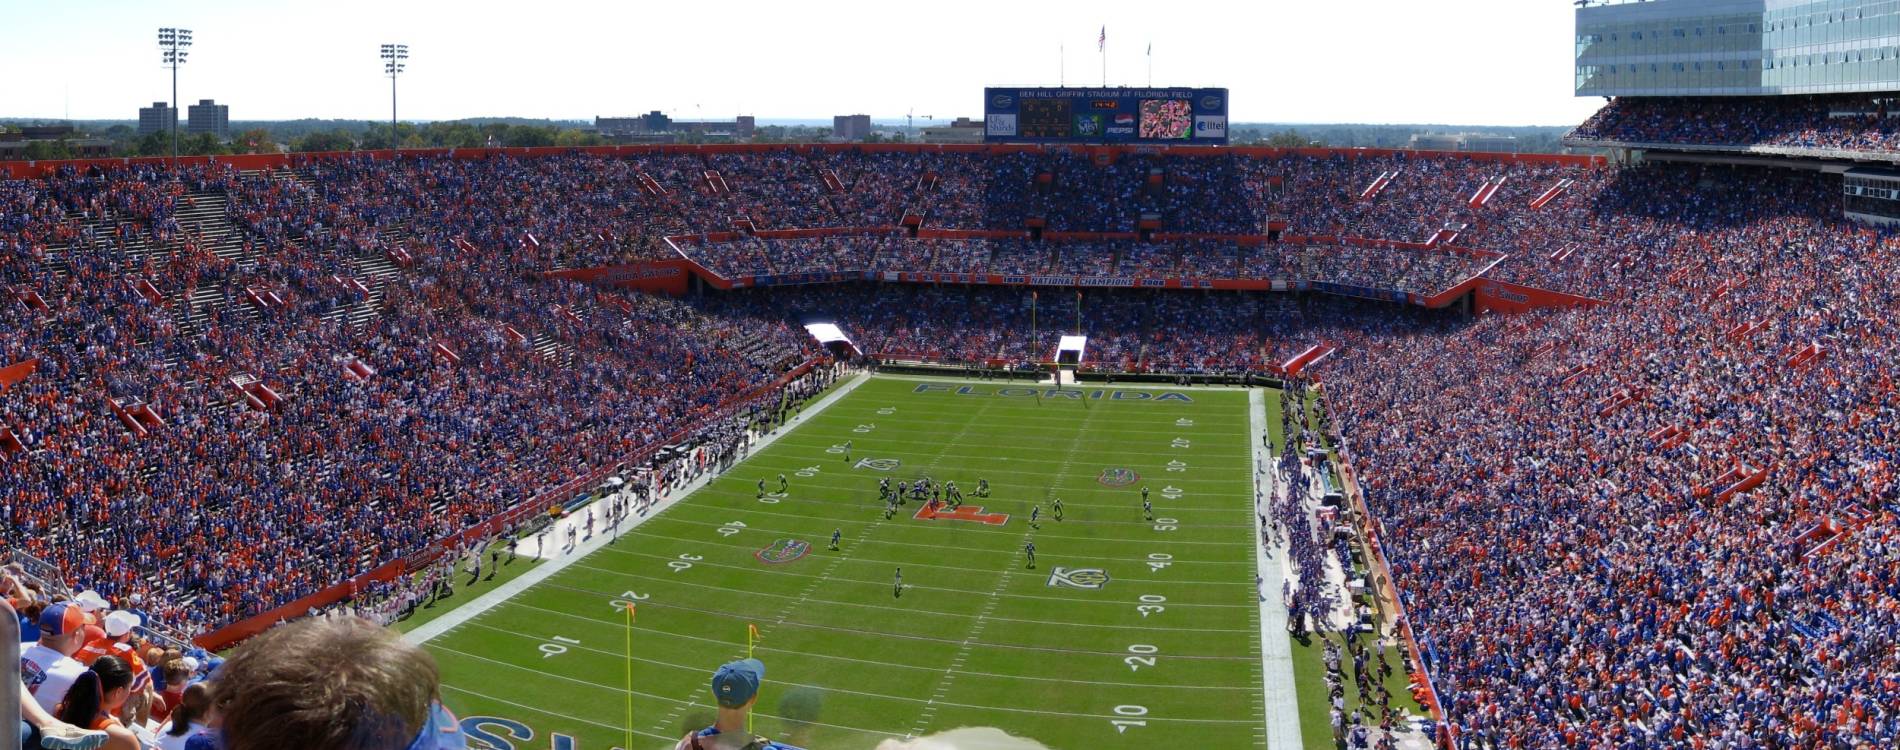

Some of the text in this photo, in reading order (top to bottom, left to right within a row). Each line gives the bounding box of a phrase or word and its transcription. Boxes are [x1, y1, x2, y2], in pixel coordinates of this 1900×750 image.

[1037, 90, 1051, 98] HILL
[1087, 90, 1119, 98] STADIUM
[1122, 90, 1131, 98] AT
[1031, 276, 1075, 286] NATIONAL
[1079, 277, 1134, 286] CHAMPIONS
[912, 383, 1194, 402] FLORIDA
[1161, 487, 1184, 499] 40
[717, 521, 747, 534] 40
[1154, 518, 1178, 531] 50
[668, 553, 703, 569] 30
[1147, 553, 1173, 570] 40
[609, 591, 649, 608] 20
[1137, 594, 1167, 614] 30
[538, 635, 580, 655] 10
[1124, 644, 1158, 666] 20
[1111, 705, 1148, 727] 10
